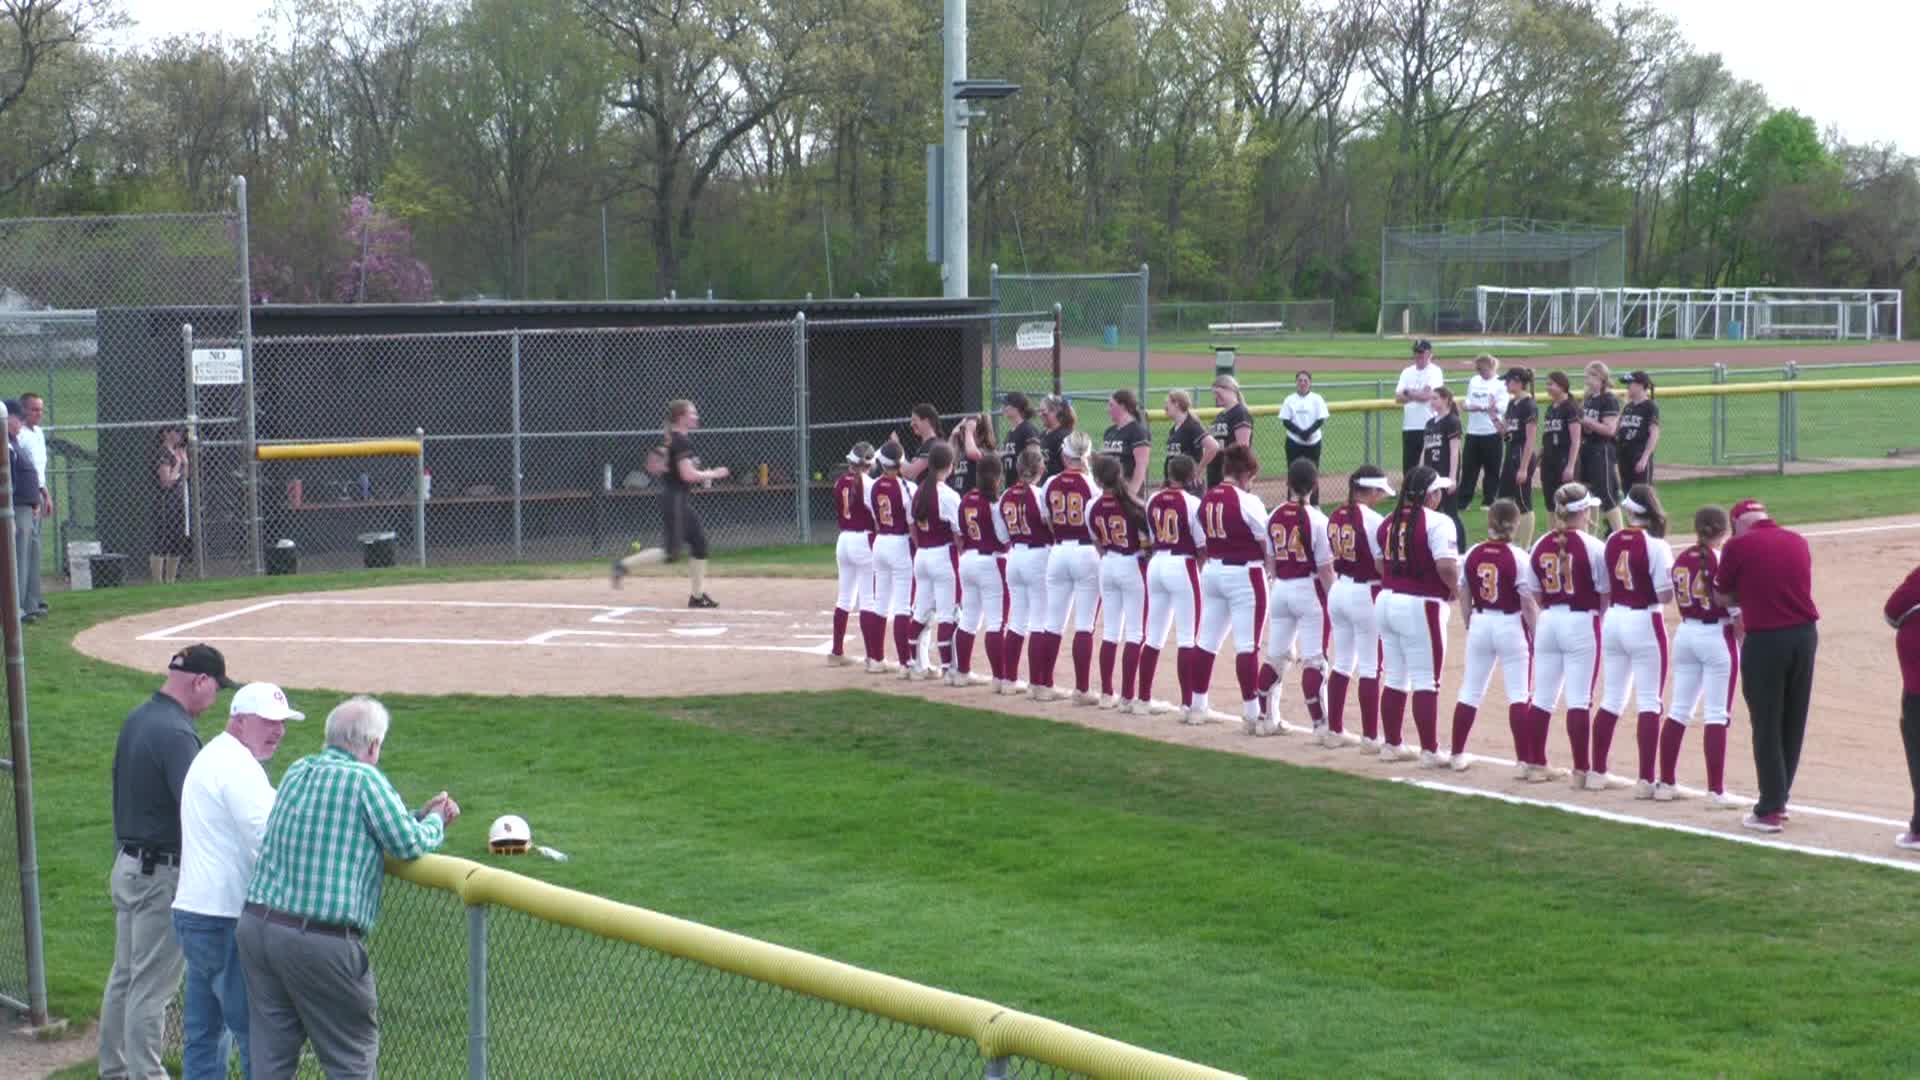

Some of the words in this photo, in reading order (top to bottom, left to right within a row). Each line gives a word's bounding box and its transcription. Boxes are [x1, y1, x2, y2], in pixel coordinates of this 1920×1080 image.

[877, 494, 894, 527] 2
[964, 507, 981, 540] 5
[1003, 501, 1031, 536] 21
[1050, 490, 1083, 526] 28
[1152, 507, 1179, 544] 10
[1205, 502, 1227, 539] 11
[1095, 515, 1129, 549] 12
[1270, 523, 1307, 562] 24
[1477, 562, 1499, 604] 3
[1539, 552, 1575, 595] 31
[1614, 550, 1635, 591] 4
[1673, 566, 1710, 610] 34
